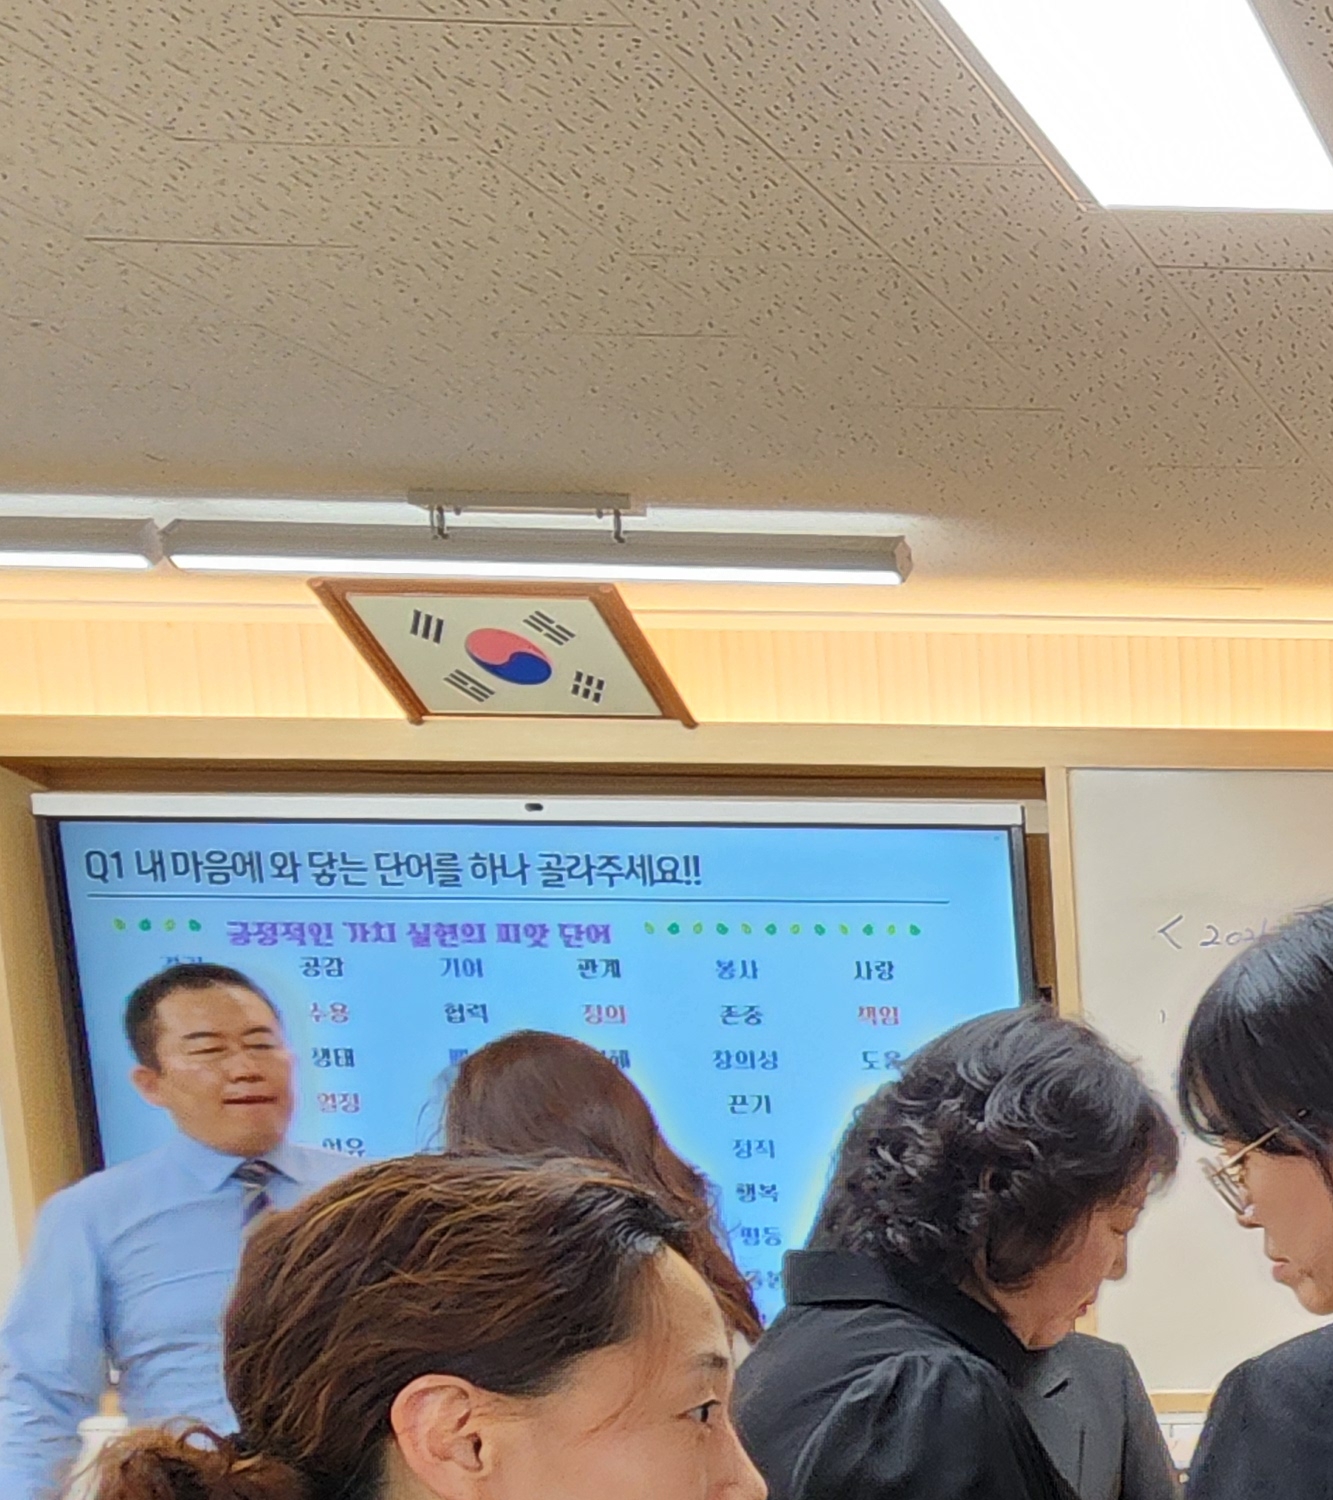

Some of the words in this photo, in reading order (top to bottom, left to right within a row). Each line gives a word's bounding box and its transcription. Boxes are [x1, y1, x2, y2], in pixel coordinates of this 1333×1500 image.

[84, 850, 123, 883] Q1
[269, 851, 302, 884] 와
[307, 851, 369, 887] 닿는
[374, 852, 463, 888] 단어를
[468, 852, 531, 887] 하나
[537, 853, 702, 888] 골라주세요!!
[342, 920, 396, 944] 가치
[407, 922, 487, 948] 실현의
[558, 923, 612, 949] 단어
[299, 956, 345, 979] 공감
[576, 958, 622, 980] 관계
[715, 959, 759, 981] 봉사
[853, 960, 895, 981] 사랑
[444, 1003, 489, 1025] 협력
[720, 1004, 764, 1026] 존중
[858, 1005, 900, 1027] 책임
[311, 1047, 356, 1069] 생태
[712, 1049, 779, 1071] 창의성
[317, 1092, 361, 1114] 열정
[727, 1094, 772, 1115] 끈기
[731, 1138, 776, 1160] 정직
[735, 1182, 779, 1204] 행복
[740, 1226, 783, 1247] 평등
